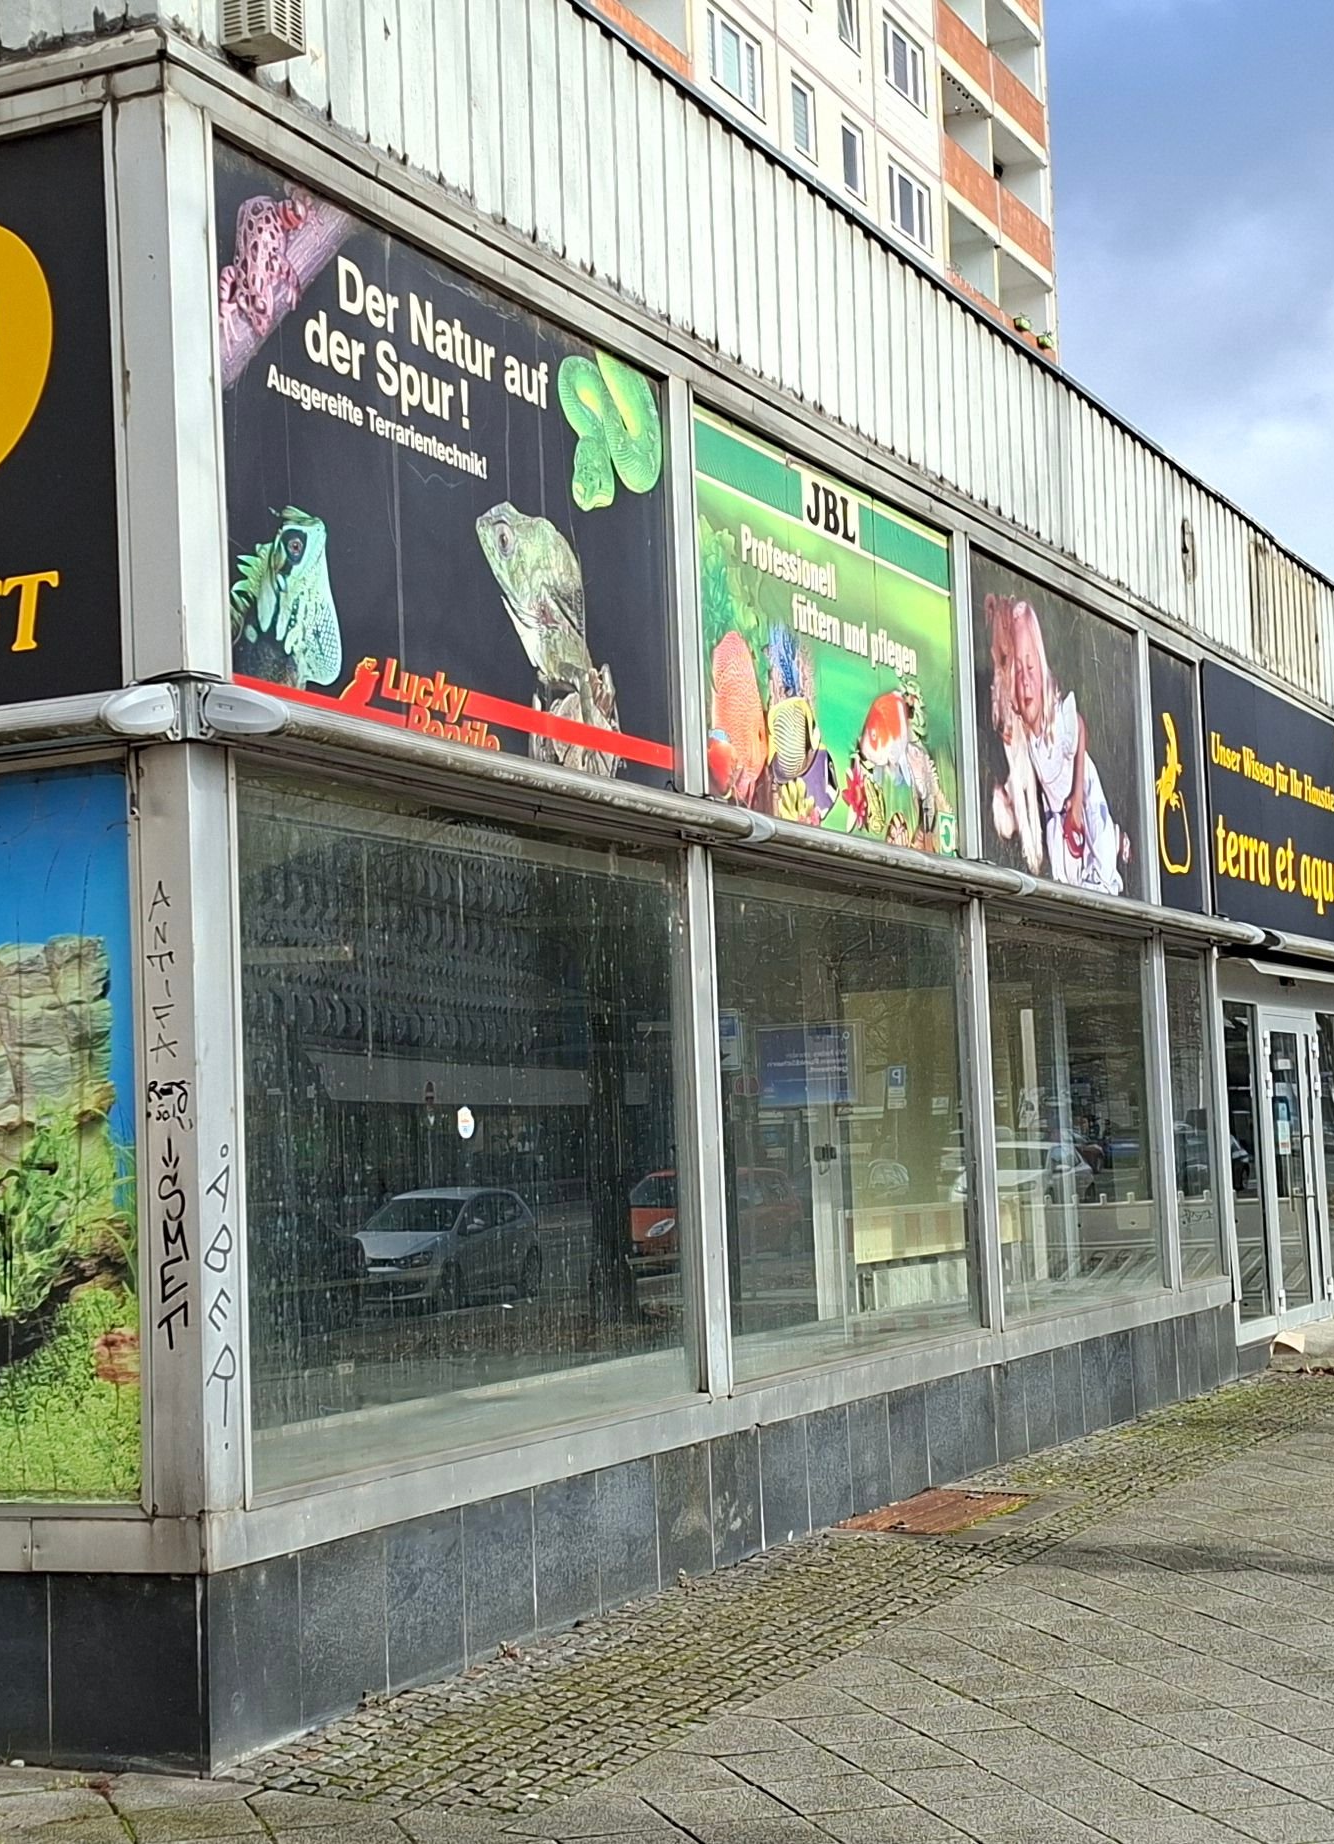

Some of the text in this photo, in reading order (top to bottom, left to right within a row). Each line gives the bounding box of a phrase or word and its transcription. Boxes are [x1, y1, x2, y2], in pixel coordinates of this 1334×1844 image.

[304, 310, 366, 381] der
[376, 340, 453, 422] Spur
[337, 255, 549, 410] Der Natur auf
[267, 364, 488, 480] Ausgereifte Terrarientechnik!
[807, 482, 856, 545] JBL
[740, 524, 837, 600] Professionell
[792, 594, 917, 678] füttern und pflegen
[381, 657, 468, 724] Lucky
[1210, 732, 1241, 774] Unser
[1242, 746, 1275, 789] Wissen
[1275, 763, 1289, 796] für
[1289, 768, 1304, 799] Ihr
[1216, 815, 1271, 887] terra
[1275, 837, 1297, 894] et
[147, 881, 179, 1059] ANTIFA
